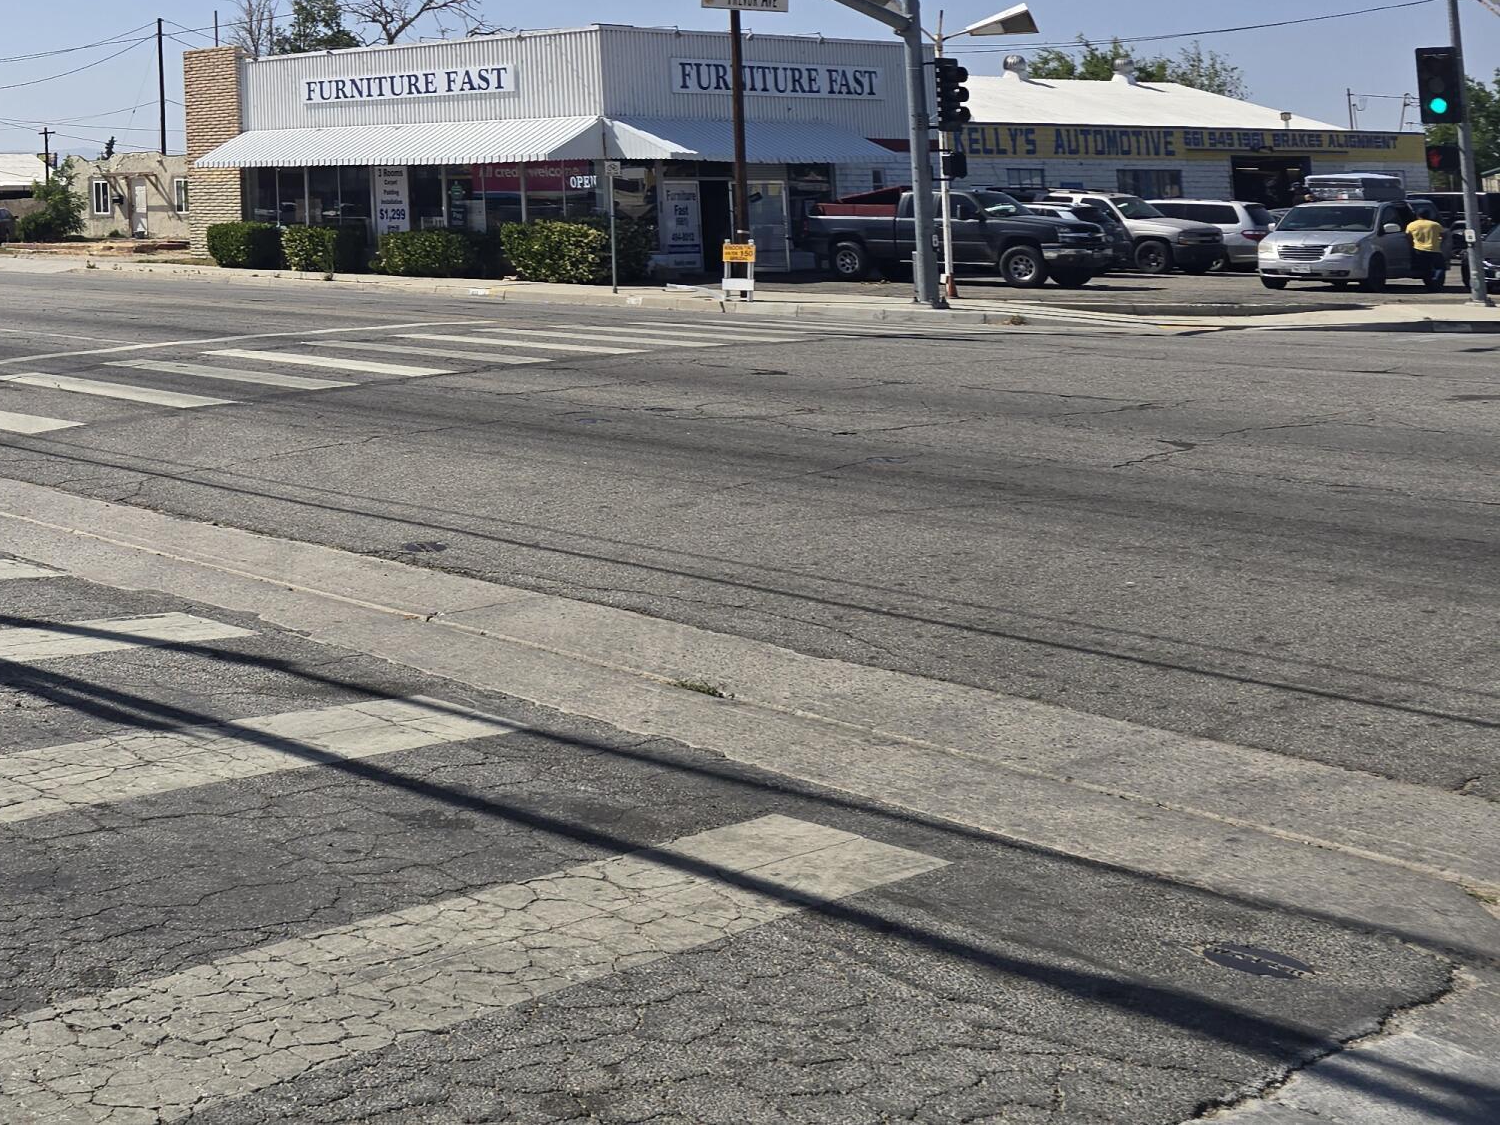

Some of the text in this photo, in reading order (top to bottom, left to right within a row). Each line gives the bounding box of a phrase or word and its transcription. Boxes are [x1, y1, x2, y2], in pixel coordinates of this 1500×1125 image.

[306, 67, 507, 101] FURNITURE FAST
[826, 68, 877, 95] FAST
[953, 127, 1037, 156] KELLY'S
[1053, 127, 1176, 157] AUTOMOTIVE
[1183, 130, 1205, 148] 661
[1273, 133, 1322, 149] BRAKES
[1328, 134, 1398, 150] ALIGNMENT
[569, 175, 597, 188] OPEN
[379, 208, 406, 221] $1,299
